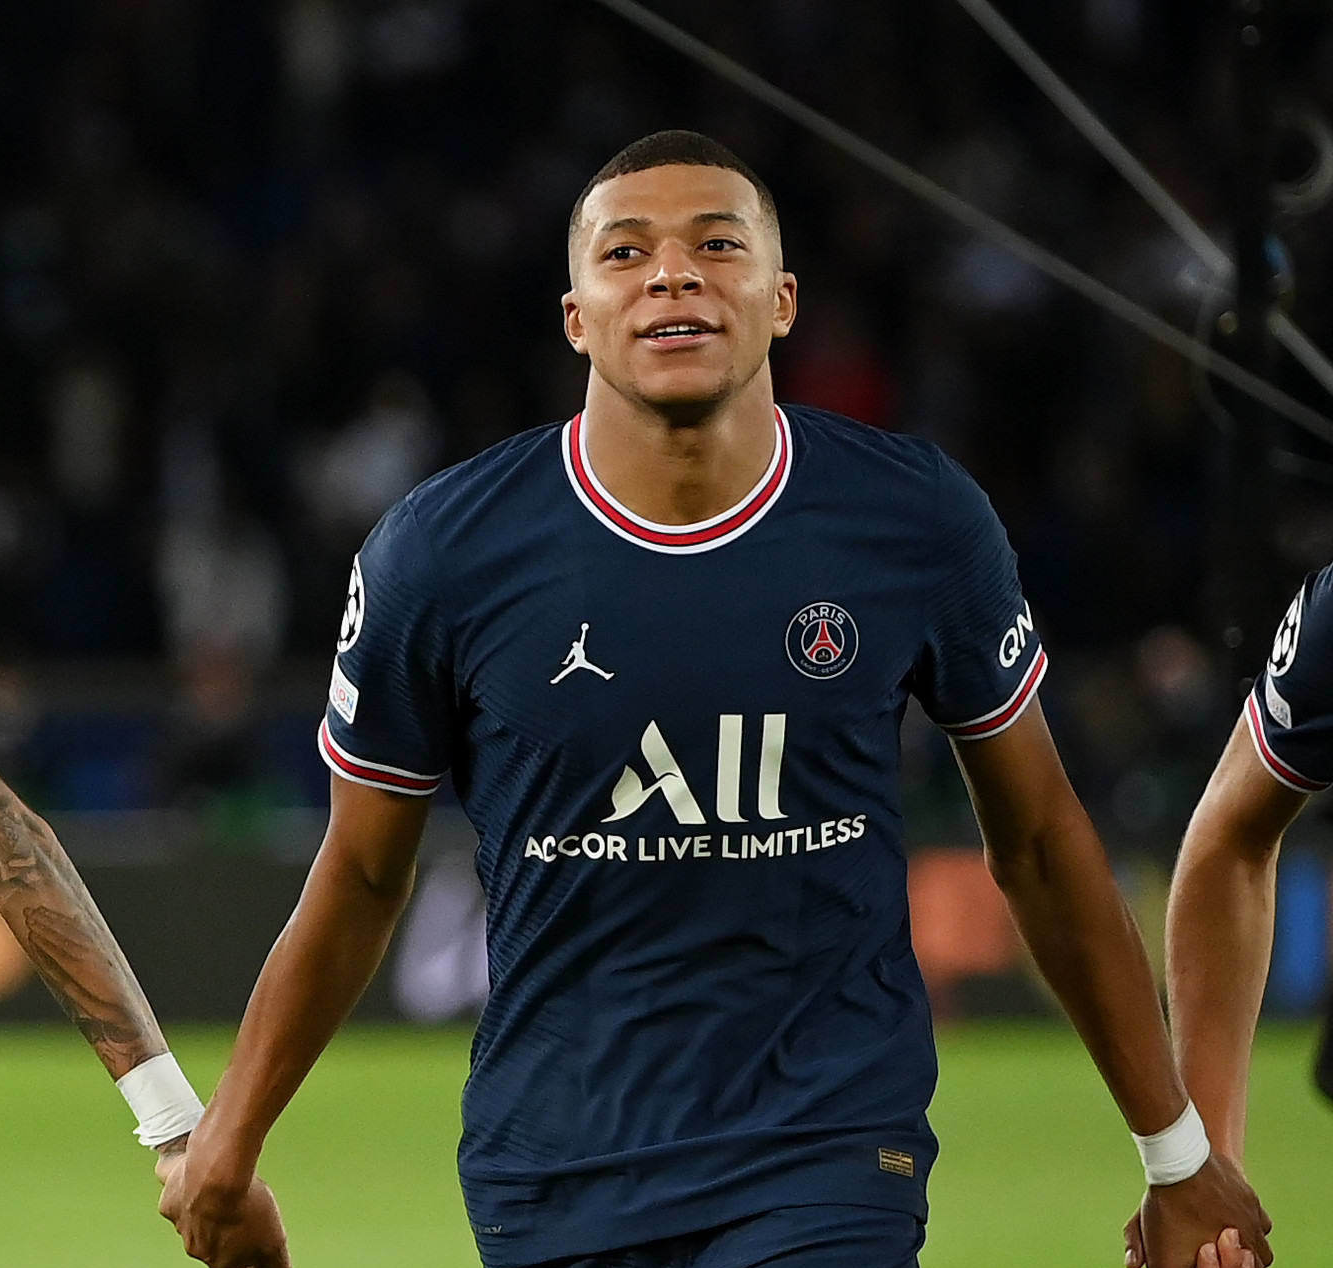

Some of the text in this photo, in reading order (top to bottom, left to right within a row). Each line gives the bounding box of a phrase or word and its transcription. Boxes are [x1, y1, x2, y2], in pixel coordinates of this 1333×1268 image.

[798, 606, 846, 626] PARIS
[998, 599, 1034, 668] QN
[524, 814, 867, 862] ACCOR LIVE LIMITLESS
